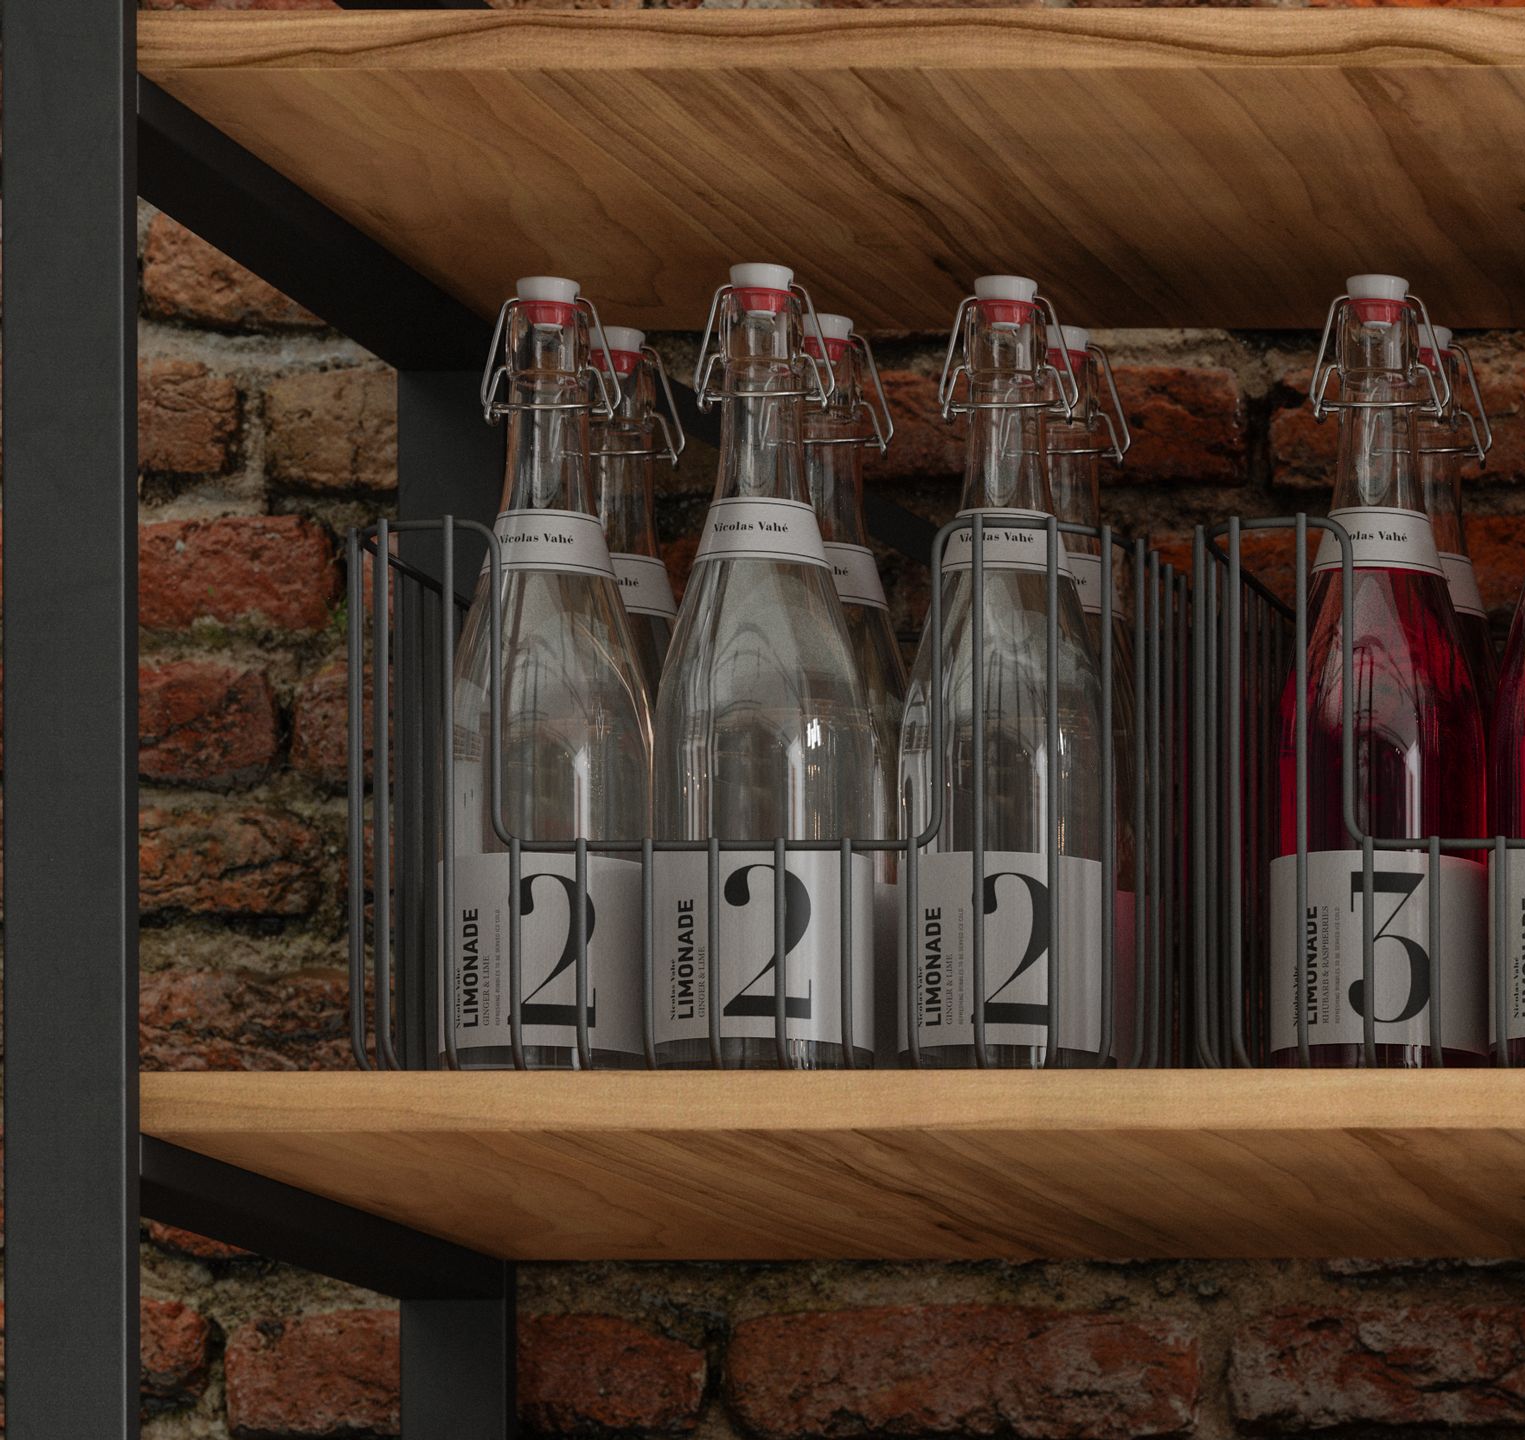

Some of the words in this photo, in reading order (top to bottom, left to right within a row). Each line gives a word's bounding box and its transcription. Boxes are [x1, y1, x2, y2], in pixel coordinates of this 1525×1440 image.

[500, 532, 539, 544] Nicolas
[544, 533, 574, 545] Vahé
[714, 521, 753, 533] Nicolas
[758, 521, 789, 533] Vahé
[960, 532, 1000, 544] Niclas
[1004, 533, 1034, 544] Vahé
[1377, 531, 1407, 543] Vahé
[463, 908, 478, 1028] LIMONADE
[482, 955, 490, 979] LIME
[509, 873, 597, 1027] 2
[678, 899, 694, 1019] LIMONADE
[698, 946, 706, 970] LIME
[722, 863, 811, 1019] 2
[925, 907, 941, 1026] LIMONADE
[970, 871, 1050, 1026] 2
[1307, 906, 1318, 1025] LIMONADE
[1348, 871, 1431, 1023] 3
[482, 990, 490, 1026] GINGER
[698, 981, 706, 1018] GINGER
